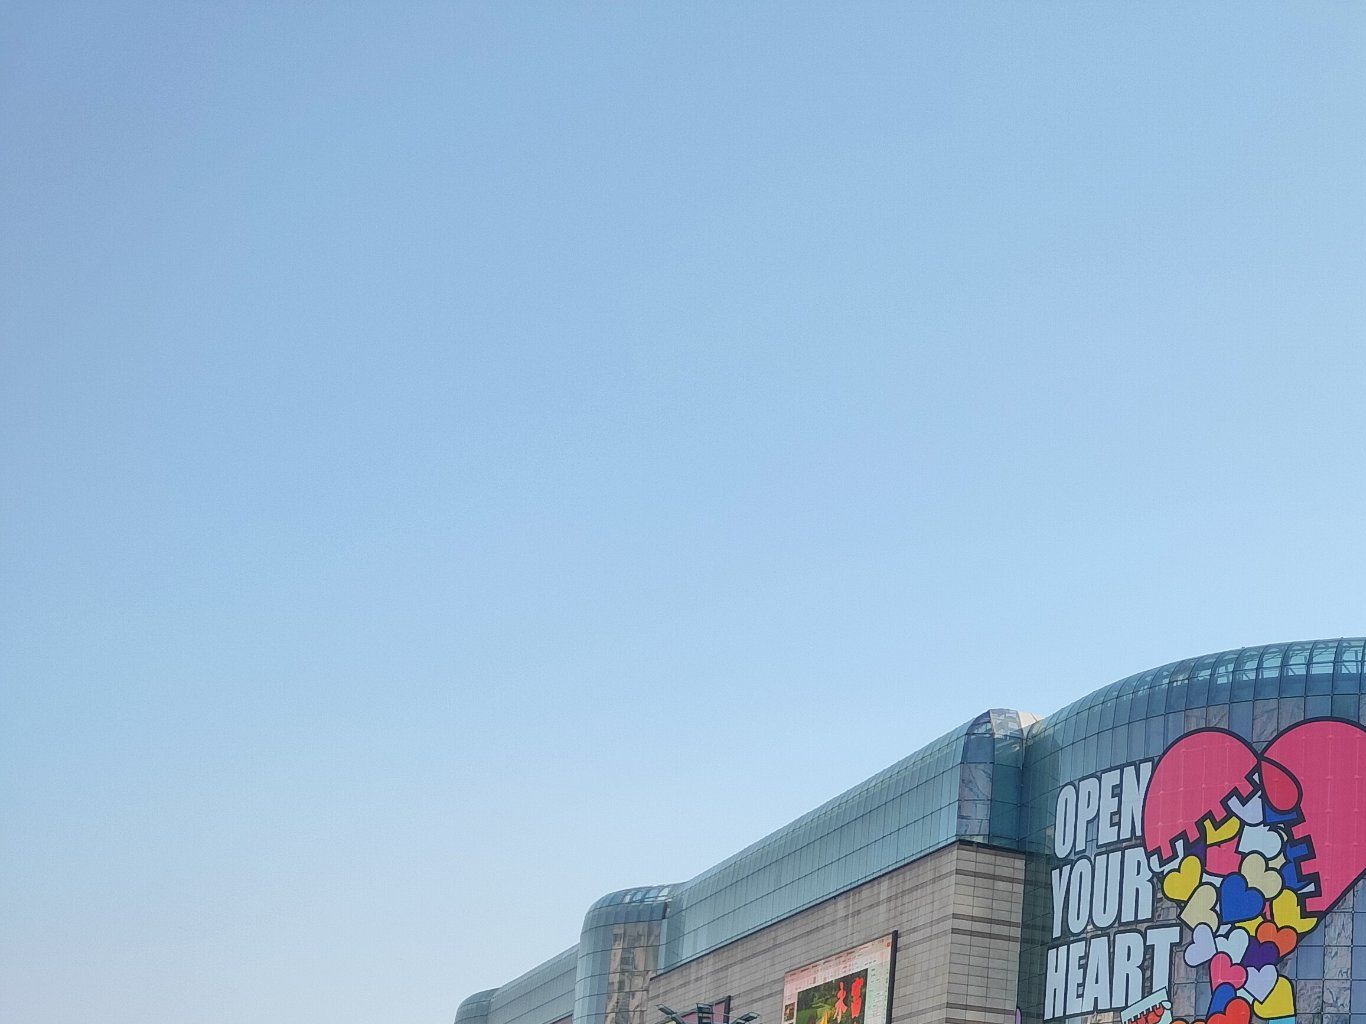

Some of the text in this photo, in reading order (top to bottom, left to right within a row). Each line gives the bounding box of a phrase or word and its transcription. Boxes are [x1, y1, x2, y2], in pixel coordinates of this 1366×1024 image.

[1055, 759, 1154, 859] OPEN
[1051, 846, 1154, 938] YOUR
[1044, 927, 1180, 1022] HEART
